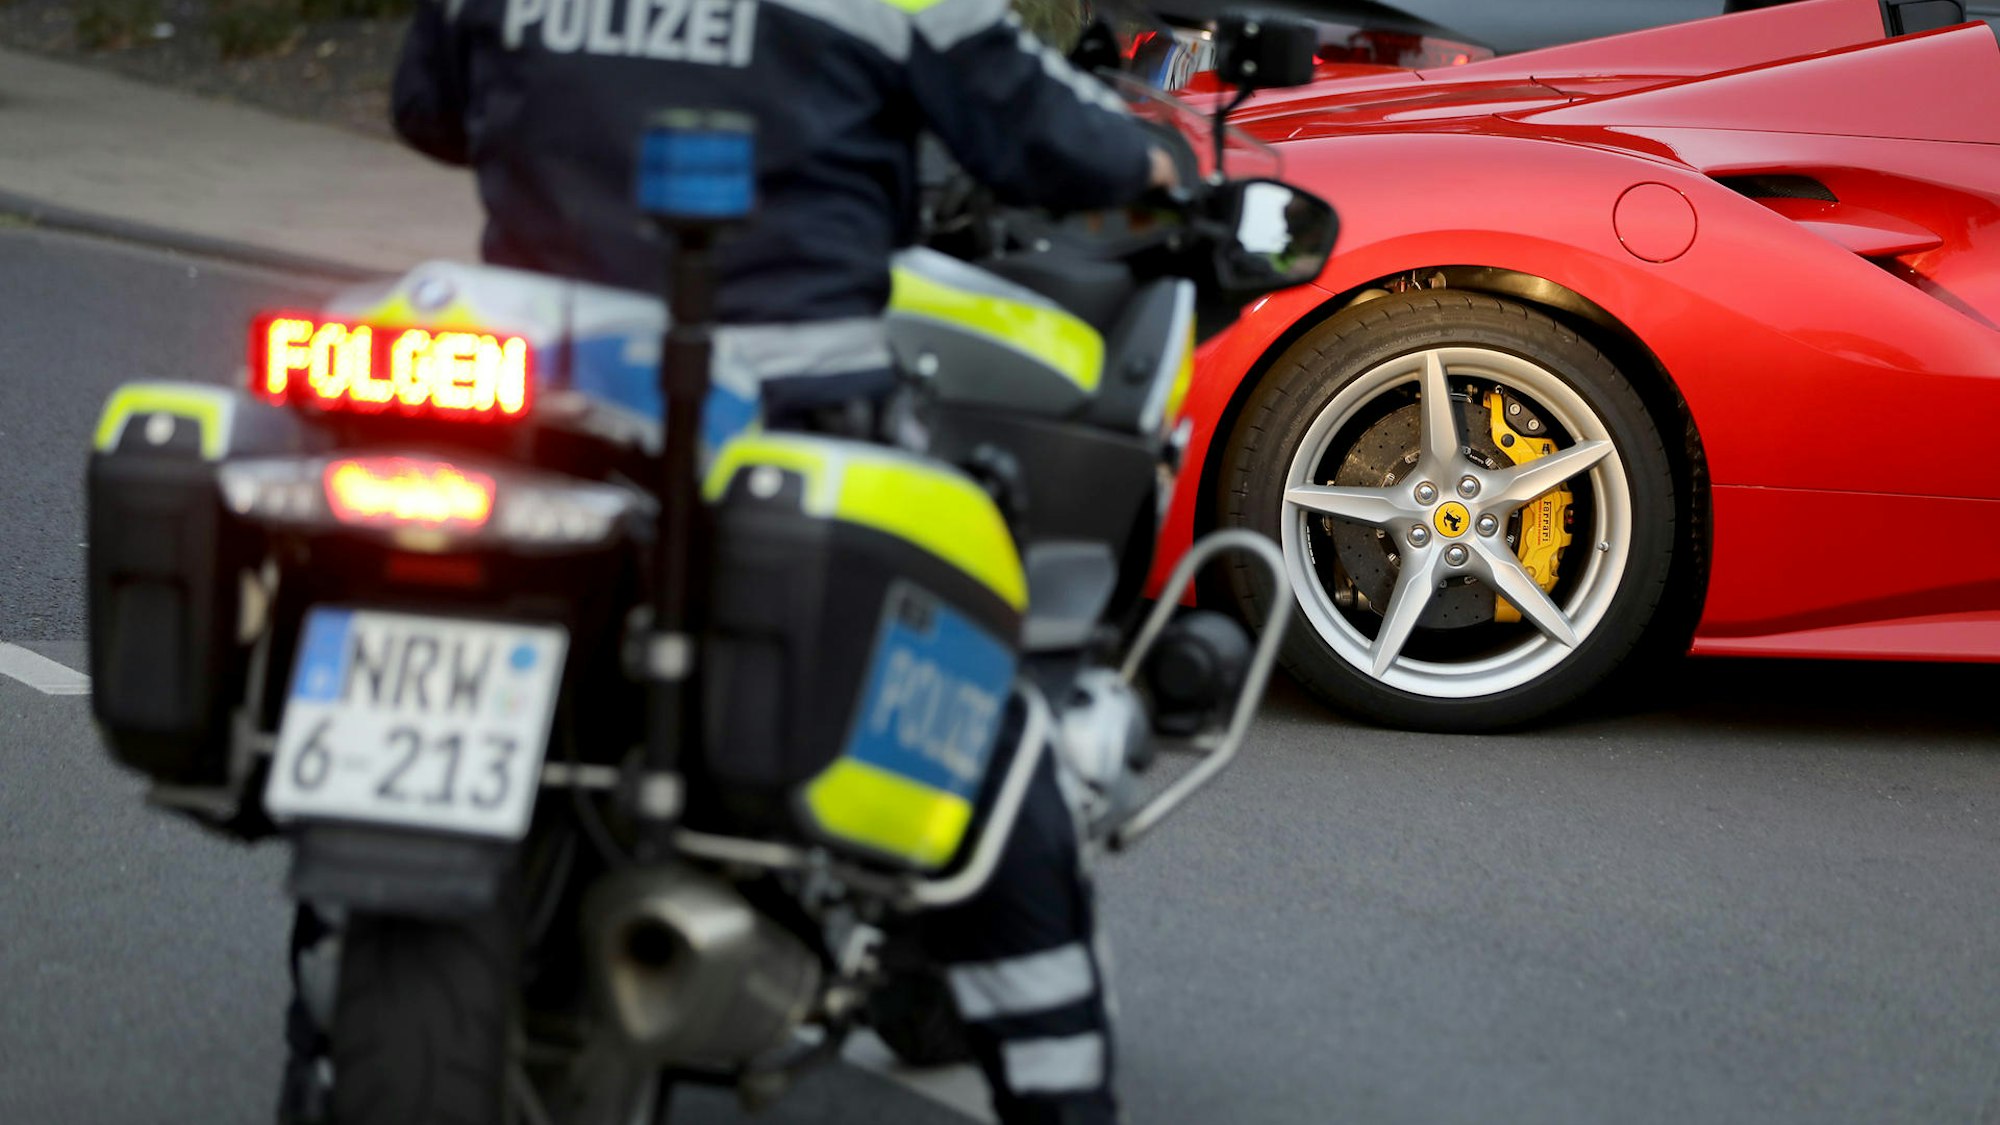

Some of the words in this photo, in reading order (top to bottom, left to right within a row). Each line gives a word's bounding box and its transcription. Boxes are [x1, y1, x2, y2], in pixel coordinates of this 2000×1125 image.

[502, 0, 757, 68] POLIZEI
[267, 318, 527, 414] FOLGEN
[1543, 501, 1552, 541] Ferrari
[345, 633, 496, 713] NRW
